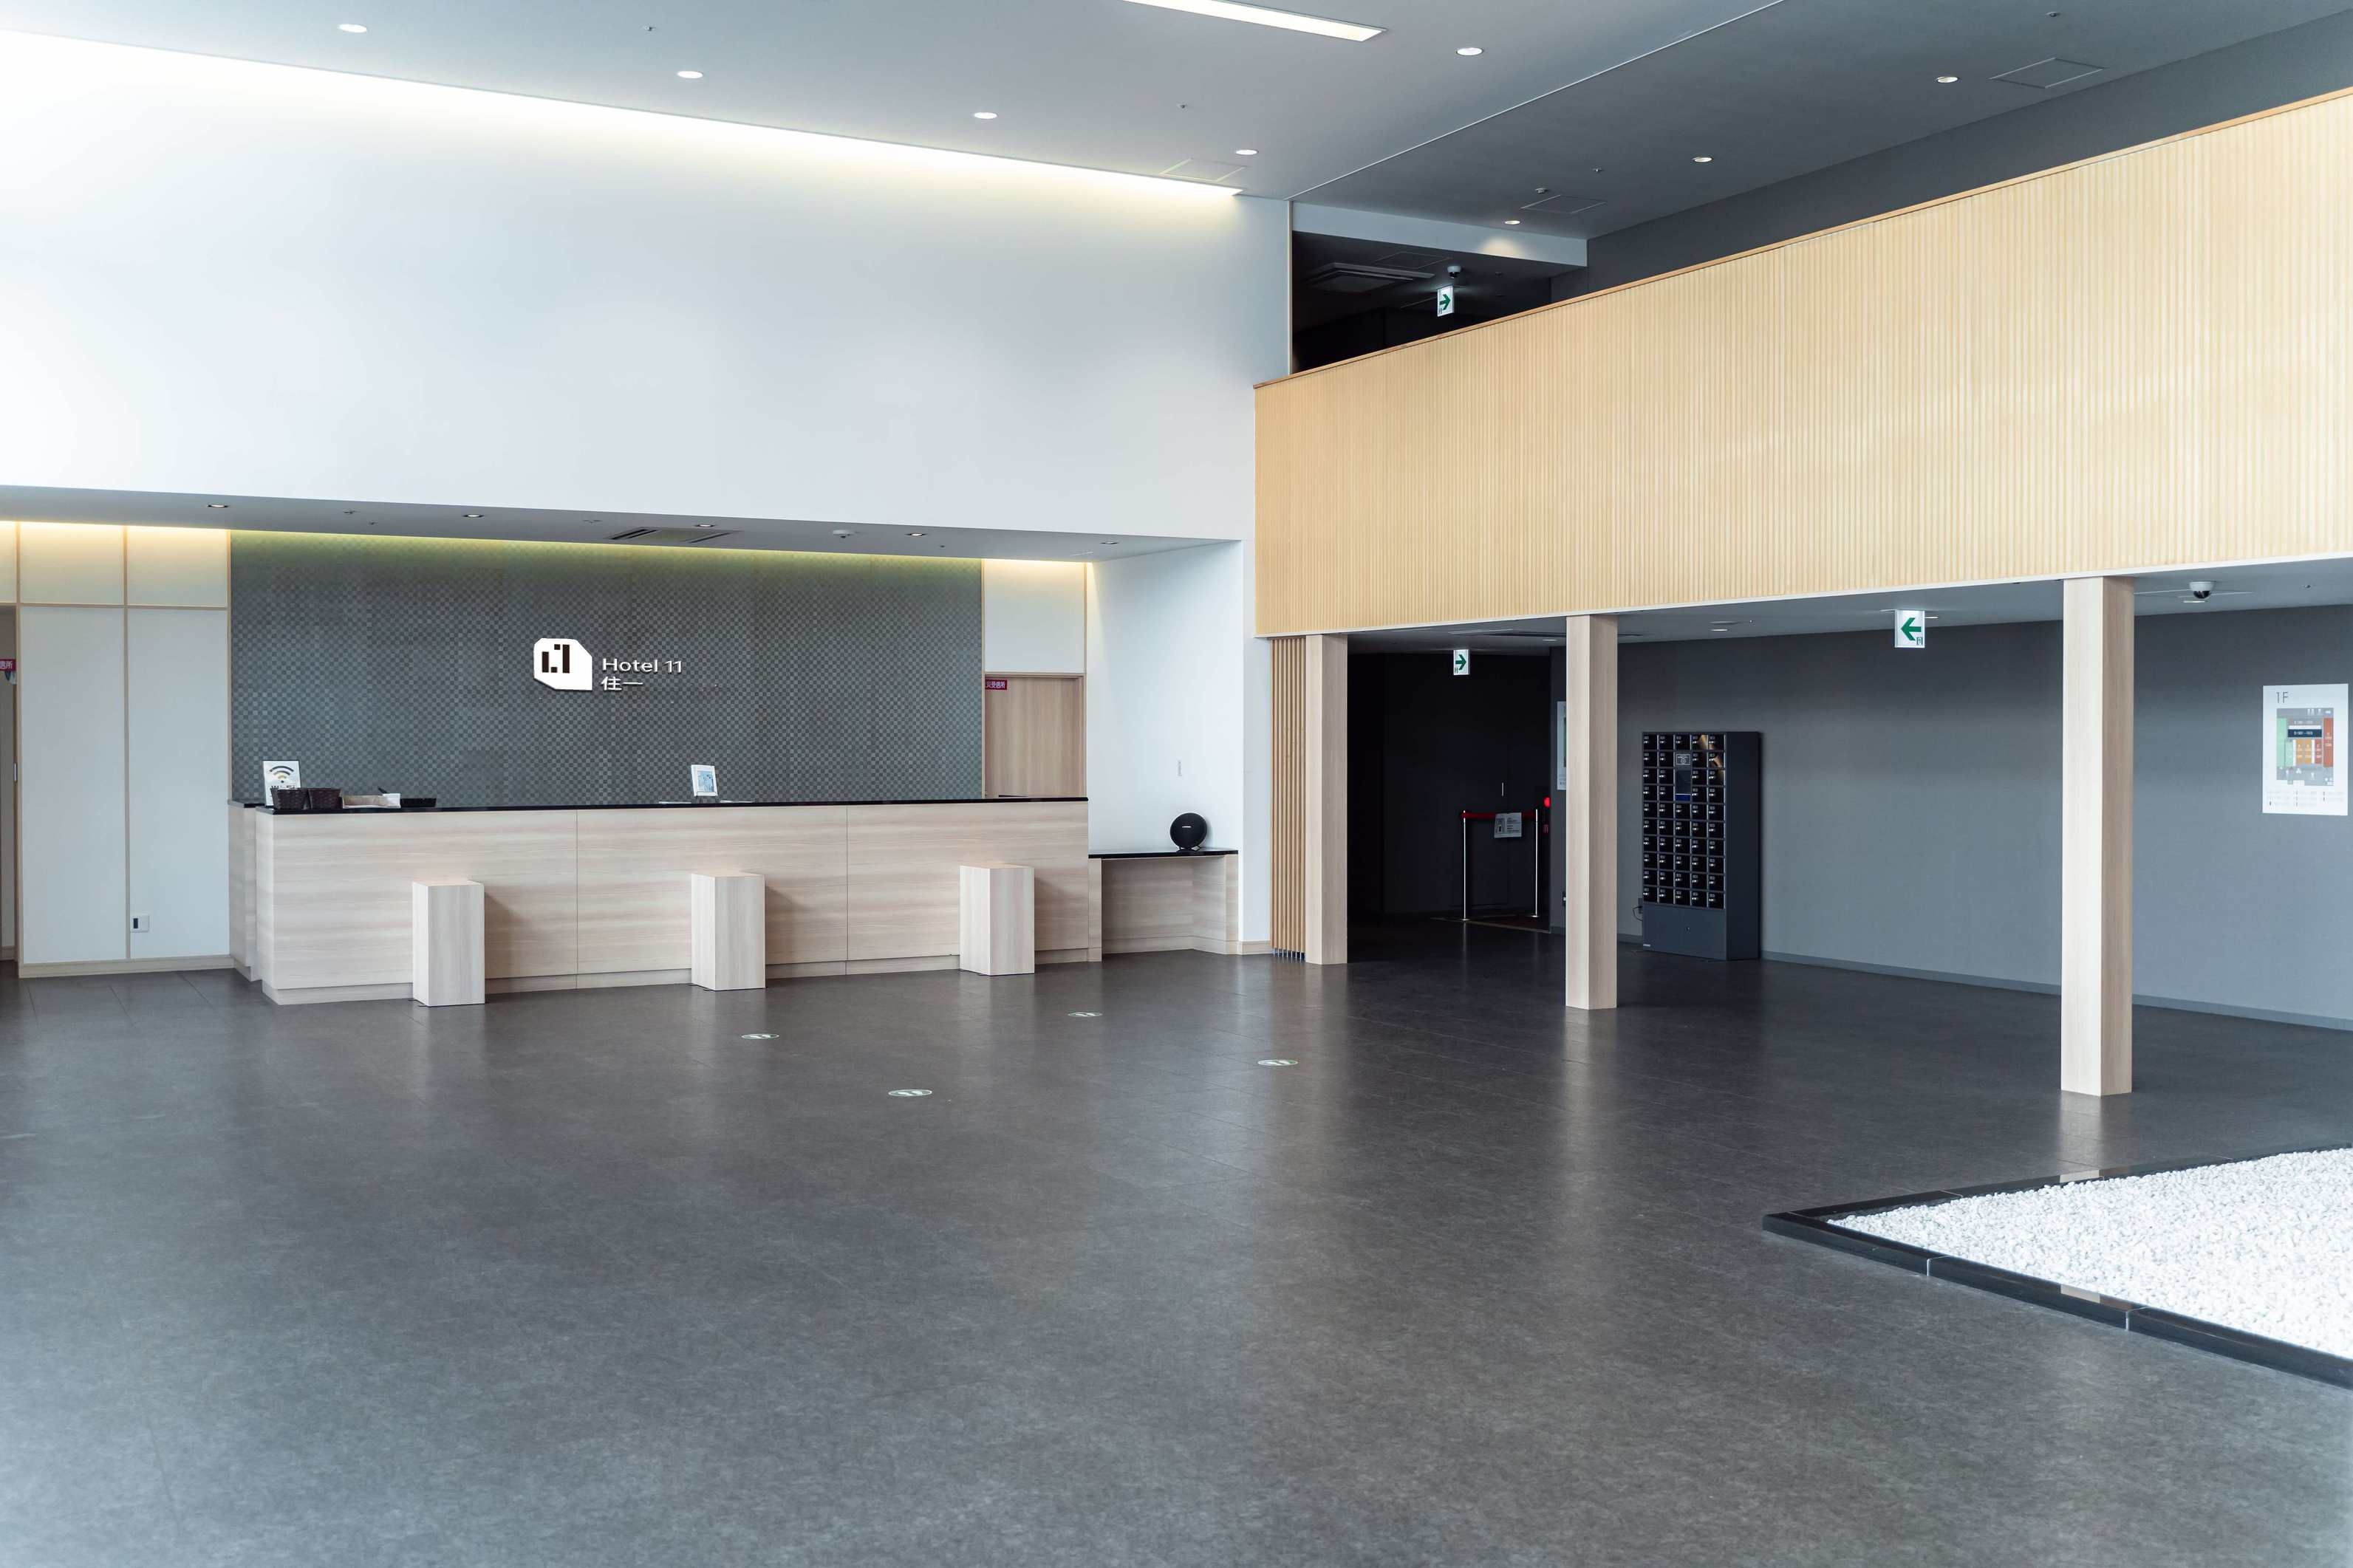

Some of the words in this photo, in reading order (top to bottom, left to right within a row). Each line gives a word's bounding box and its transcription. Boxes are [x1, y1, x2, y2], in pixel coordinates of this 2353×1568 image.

[603, 658, 658, 671] Hotel
[665, 660, 681, 673] 11
[2276, 691, 2289, 704] 1F
